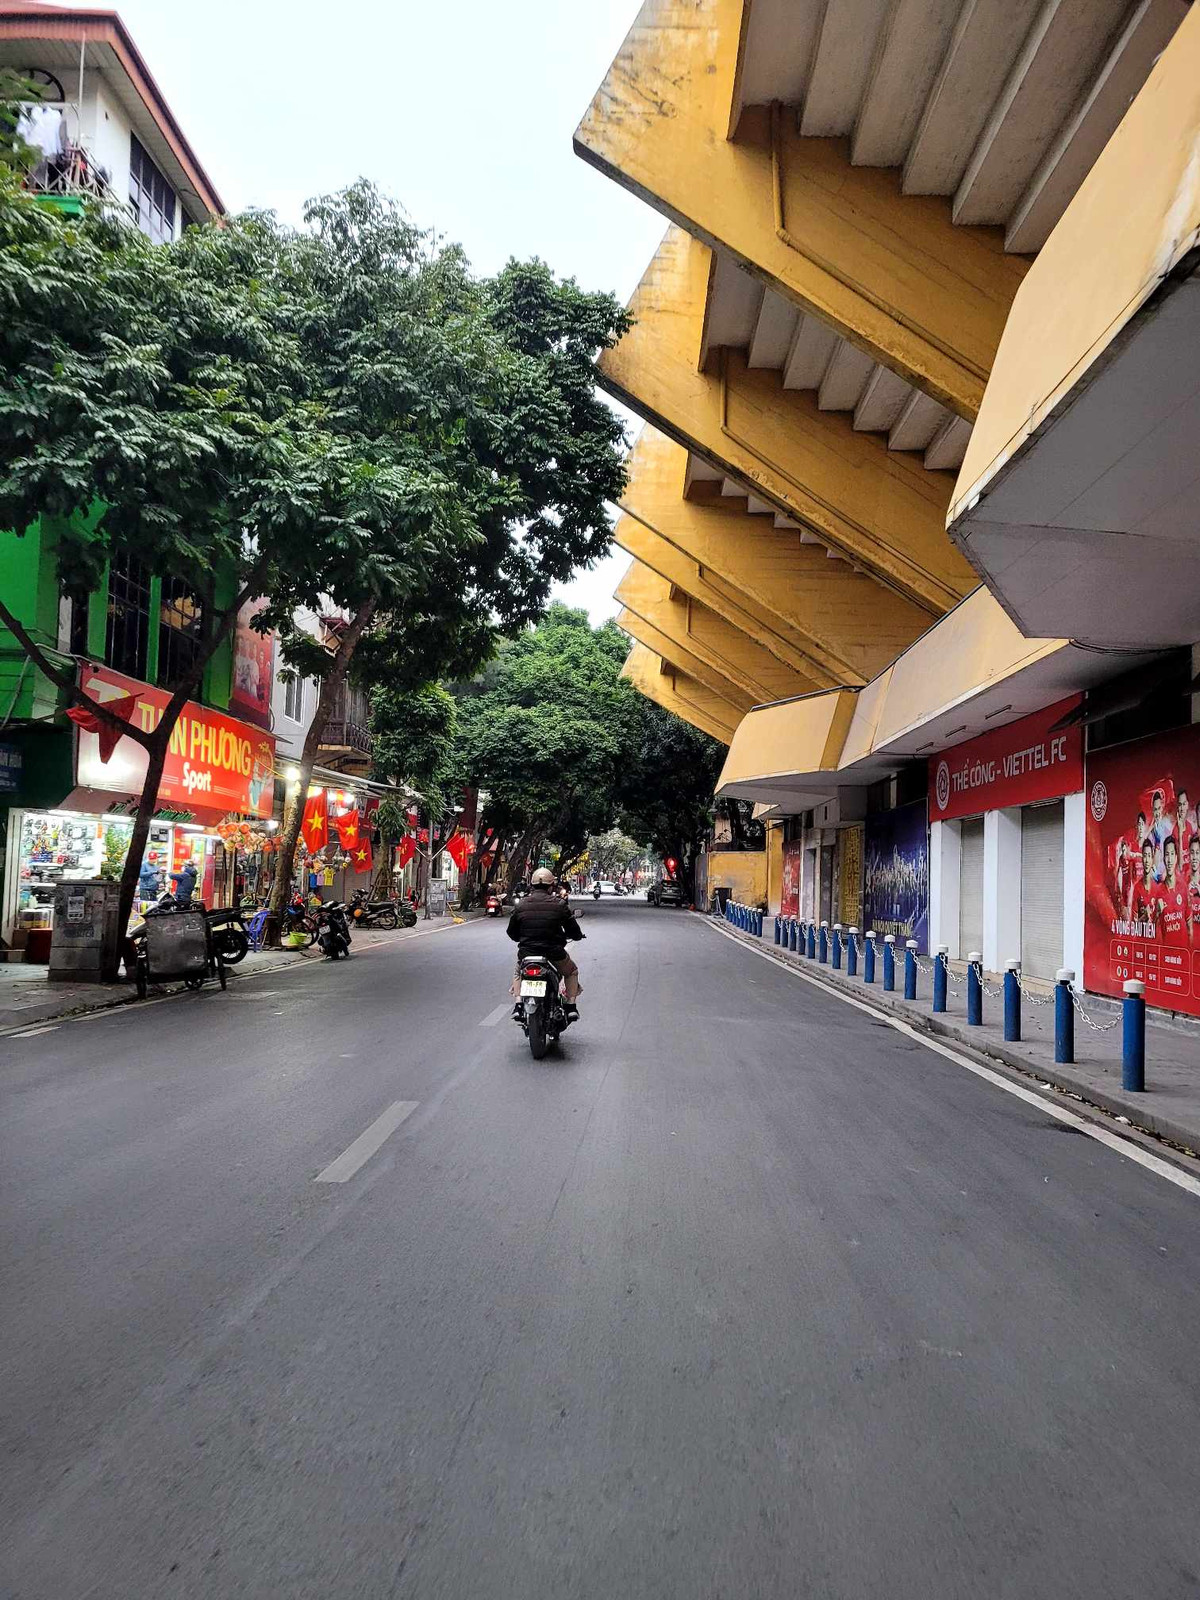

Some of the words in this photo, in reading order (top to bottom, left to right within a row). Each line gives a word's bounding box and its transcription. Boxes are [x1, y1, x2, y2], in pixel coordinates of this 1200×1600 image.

[138, 701, 187, 758] TUN
[182, 761, 211, 795] Sport
[952, 758, 969, 792] THỂ
[970, 760, 995, 788] CÔNG
[1003, 743, 1049, 778] VIETTEL
[1051, 736, 1066, 764] FC
